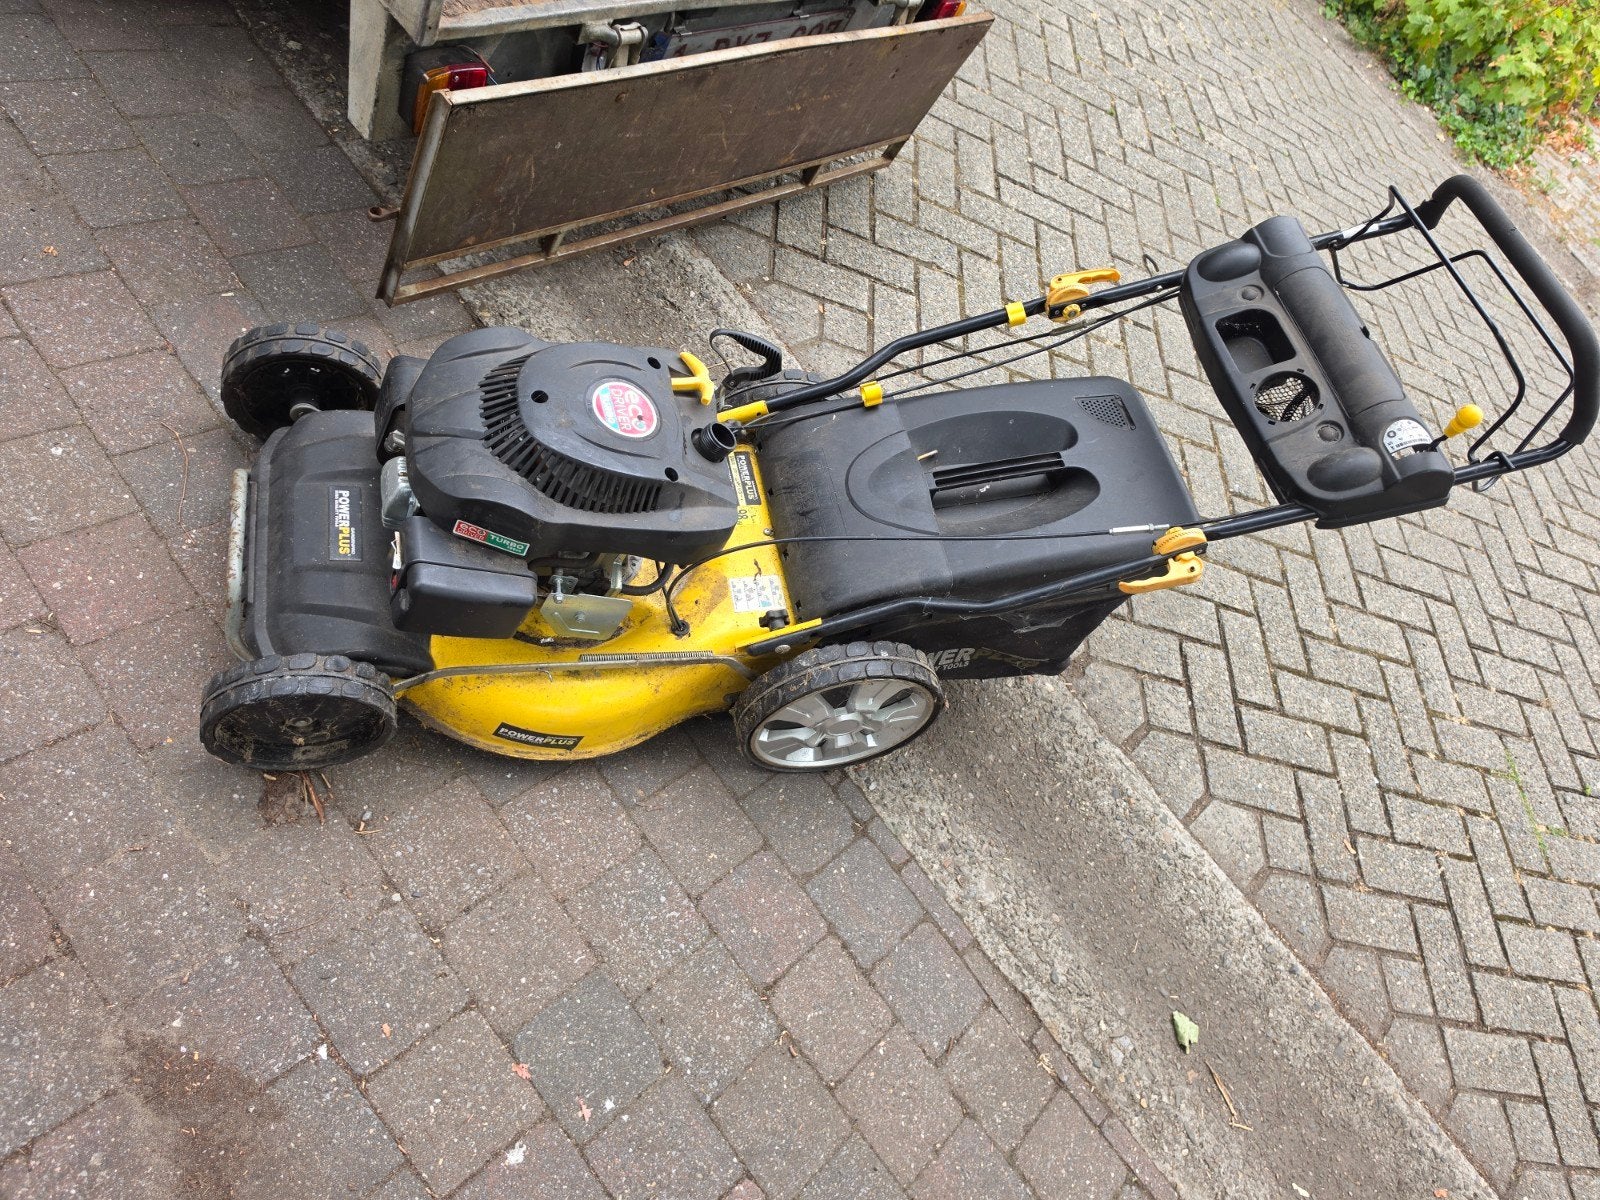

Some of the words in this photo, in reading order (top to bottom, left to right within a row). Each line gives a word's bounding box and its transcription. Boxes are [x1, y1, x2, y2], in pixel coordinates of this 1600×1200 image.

[611, 389, 632, 431] DRIVER
[624, 390, 647, 431] eco
[739, 455, 754, 500] POWERPLUS
[339, 490, 350, 555] POWERPLUS
[460, 524, 486, 535] eco
[491, 535, 525, 549] TURBO
[944, 661, 970, 670] TOOLS
[499, 728, 575, 745] POWERPLUS
